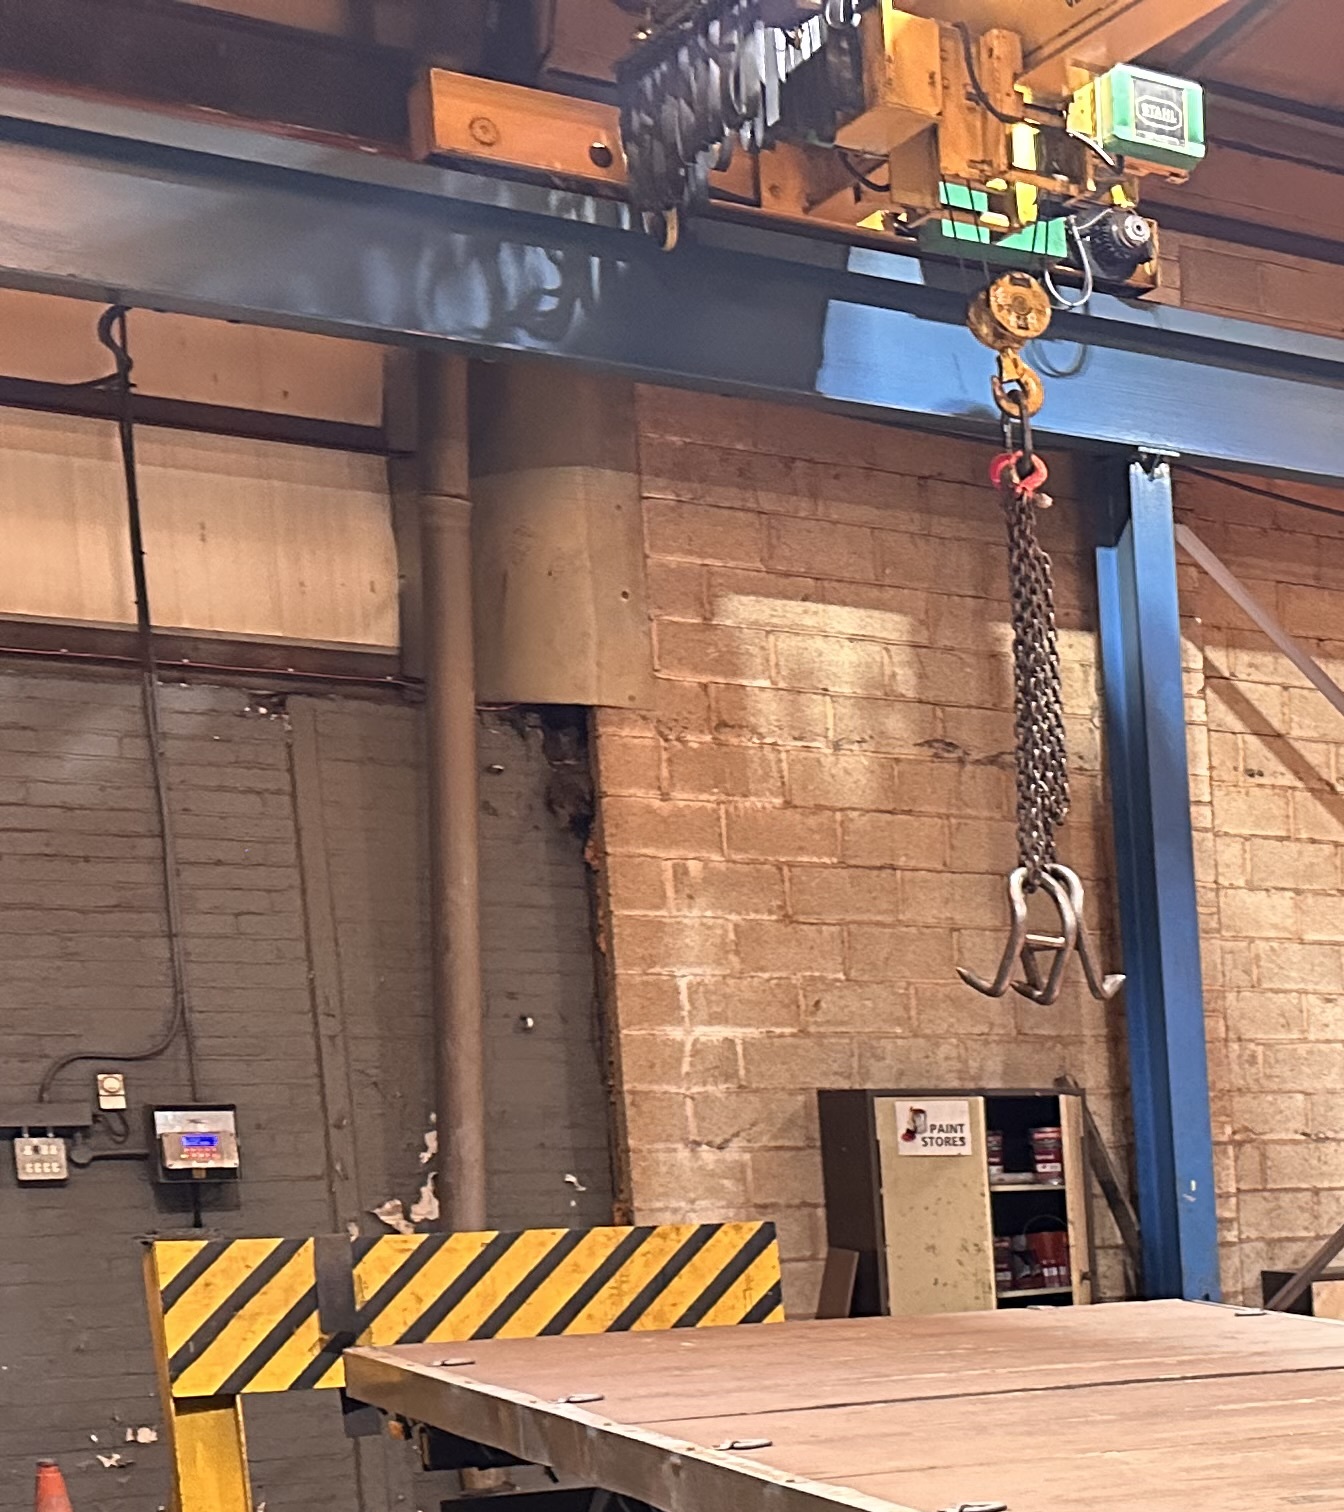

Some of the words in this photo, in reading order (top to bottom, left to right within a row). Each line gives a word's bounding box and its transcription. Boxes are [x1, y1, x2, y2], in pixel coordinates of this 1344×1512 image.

[1140, 102, 1178, 125] STAHL
[929, 1123, 965, 1134] PAINT
[921, 1136, 967, 1147] STORES
